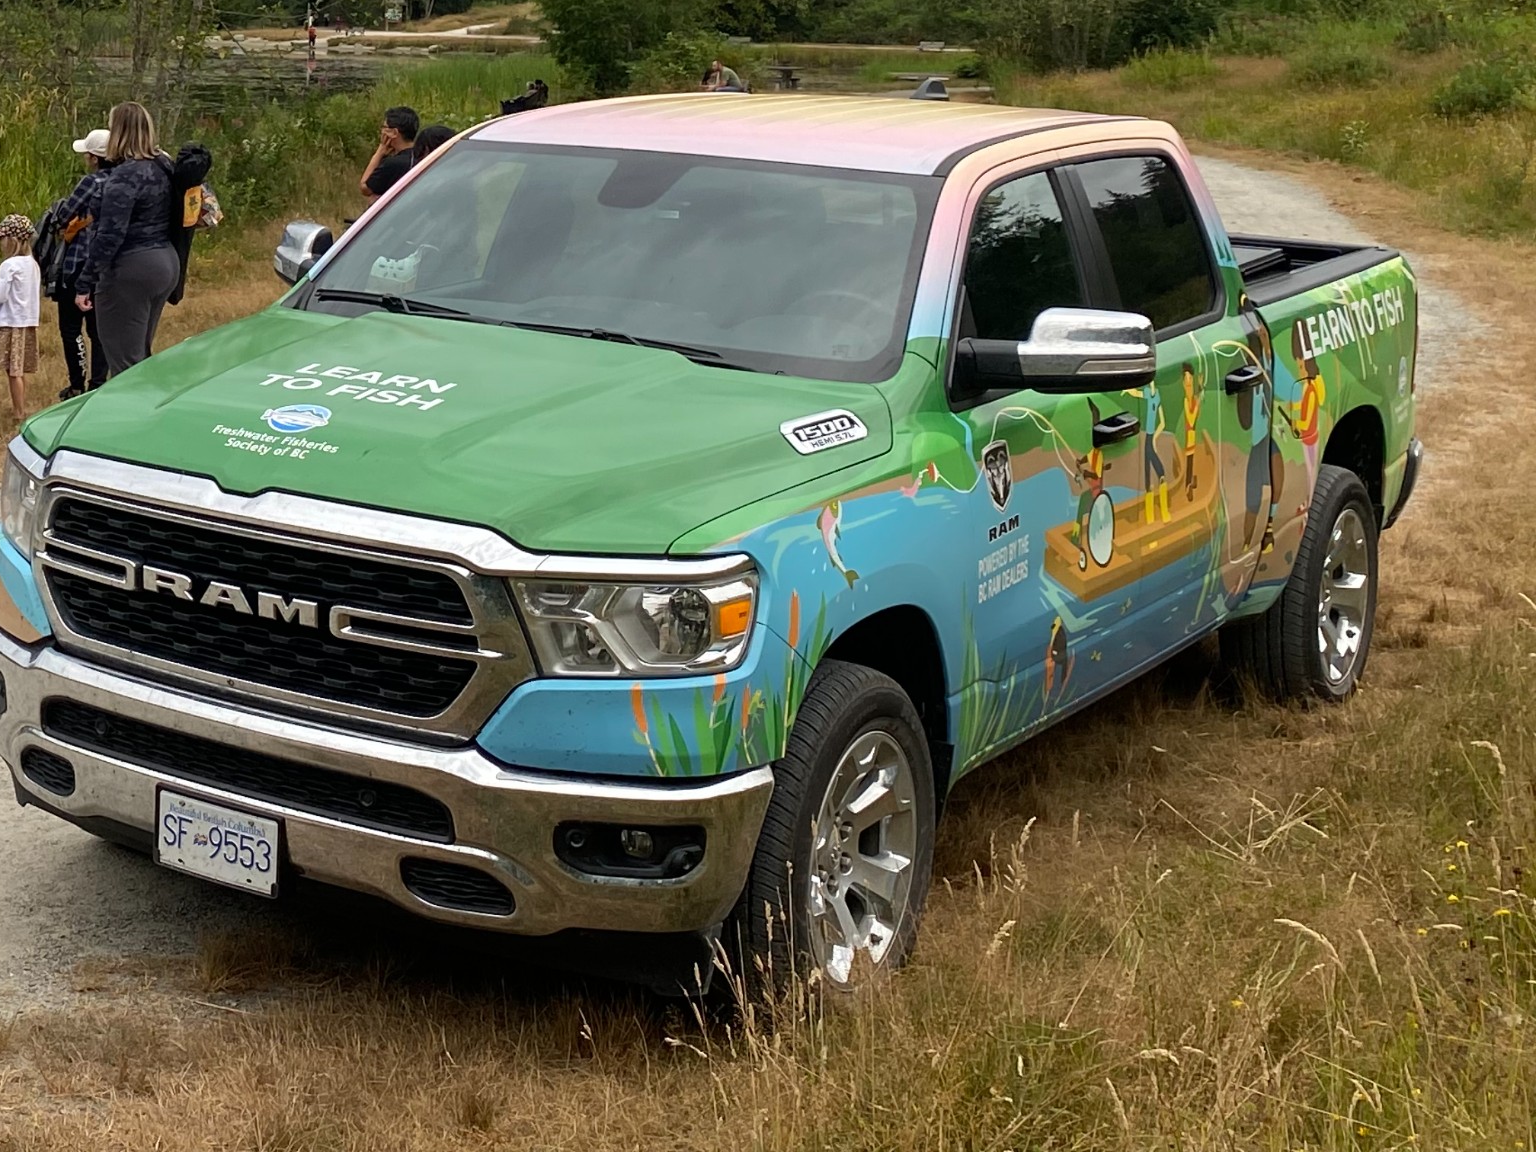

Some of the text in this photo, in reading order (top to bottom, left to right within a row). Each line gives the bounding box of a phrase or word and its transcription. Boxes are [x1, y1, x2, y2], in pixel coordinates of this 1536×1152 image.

[1297, 286, 1404, 360] LEARN TO FISH
[259, 373, 445, 410] TO FISH
[295, 363, 458, 394] LEARN
[212, 424, 339, 454] Freshwater Fisheries
[794, 417, 852, 441] 1500
[811, 431, 855, 449] HEMI 5.7L
[224, 437, 310, 460] Society of BC
[989, 514, 1020, 542] RAM
[978, 546, 1008, 579] POWERED
[1002, 559, 1028, 590] DEALERS
[143, 564, 319, 629] RAM
[164, 814, 271, 872] SF 9553
